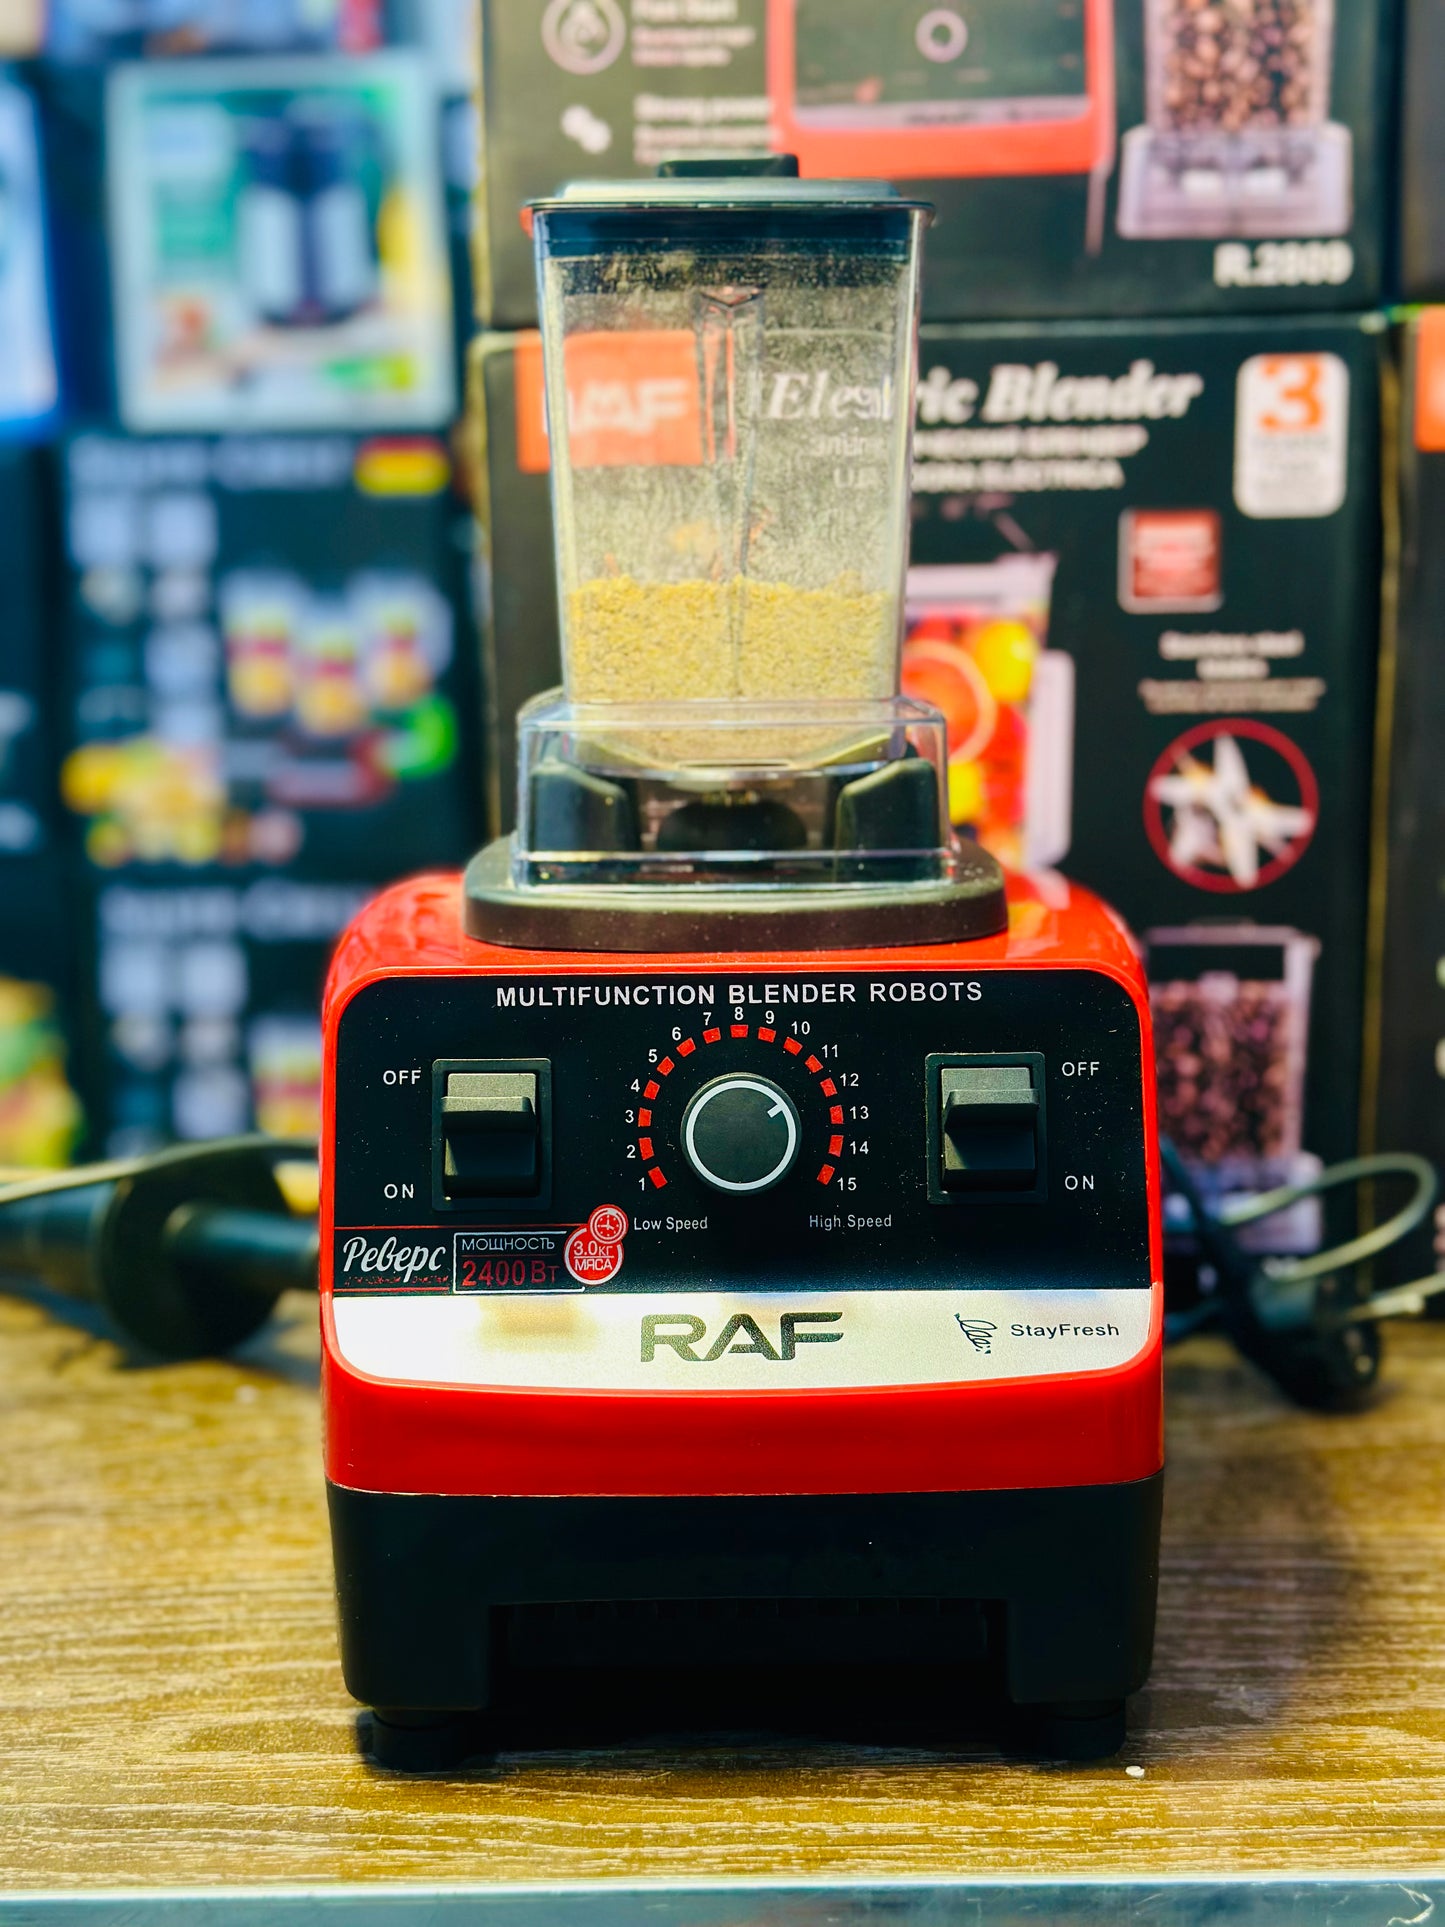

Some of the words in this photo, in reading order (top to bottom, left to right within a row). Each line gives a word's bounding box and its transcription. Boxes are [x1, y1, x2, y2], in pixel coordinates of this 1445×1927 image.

[983, 359, 1203, 421] Blender
[1258, 352, 1324, 432] 3
[496, 984, 715, 1007] MULTIFUNCTION
[728, 983, 856, 1004] BLENDER
[869, 981, 982, 1003] ROBOTS
[702, 1011, 712, 1026] 7
[734, 1006, 744, 1021] 8
[765, 1010, 775, 1025] 9
[671, 1026, 682, 1041] 6
[791, 1020, 811, 1035] 10
[648, 1048, 658, 1063] 5
[821, 1044, 839, 1059] 11
[1061, 1061, 1100, 1077] OFF
[383, 1069, 422, 1086] OFF
[839, 1072, 859, 1087] 12
[630, 1078, 641, 1093] 4
[625, 1109, 635, 1124] 3
[849, 1105, 869, 1120] 13
[626, 1144, 636, 1159] 2
[849, 1140, 869, 1155] 14
[637, 1177, 646, 1191] 1
[837, 1177, 857, 1191] 15
[1064, 1175, 1095, 1191] ON
[384, 1183, 415, 1199] ON
[633, 1217, 662, 1231] Low
[666, 1216, 709, 1233] Speed
[809, 1215, 841, 1232] High
[847, 1214, 893, 1231] Speed
[461, 1237, 556, 1252] МОЩНОСТЬ
[342, 1235, 447, 1284] Реверс
[573, 1257, 614, 1272] МЯСА
[640, 1311, 845, 1363] RAF
[1010, 1323, 1120, 1340] StayFresh
